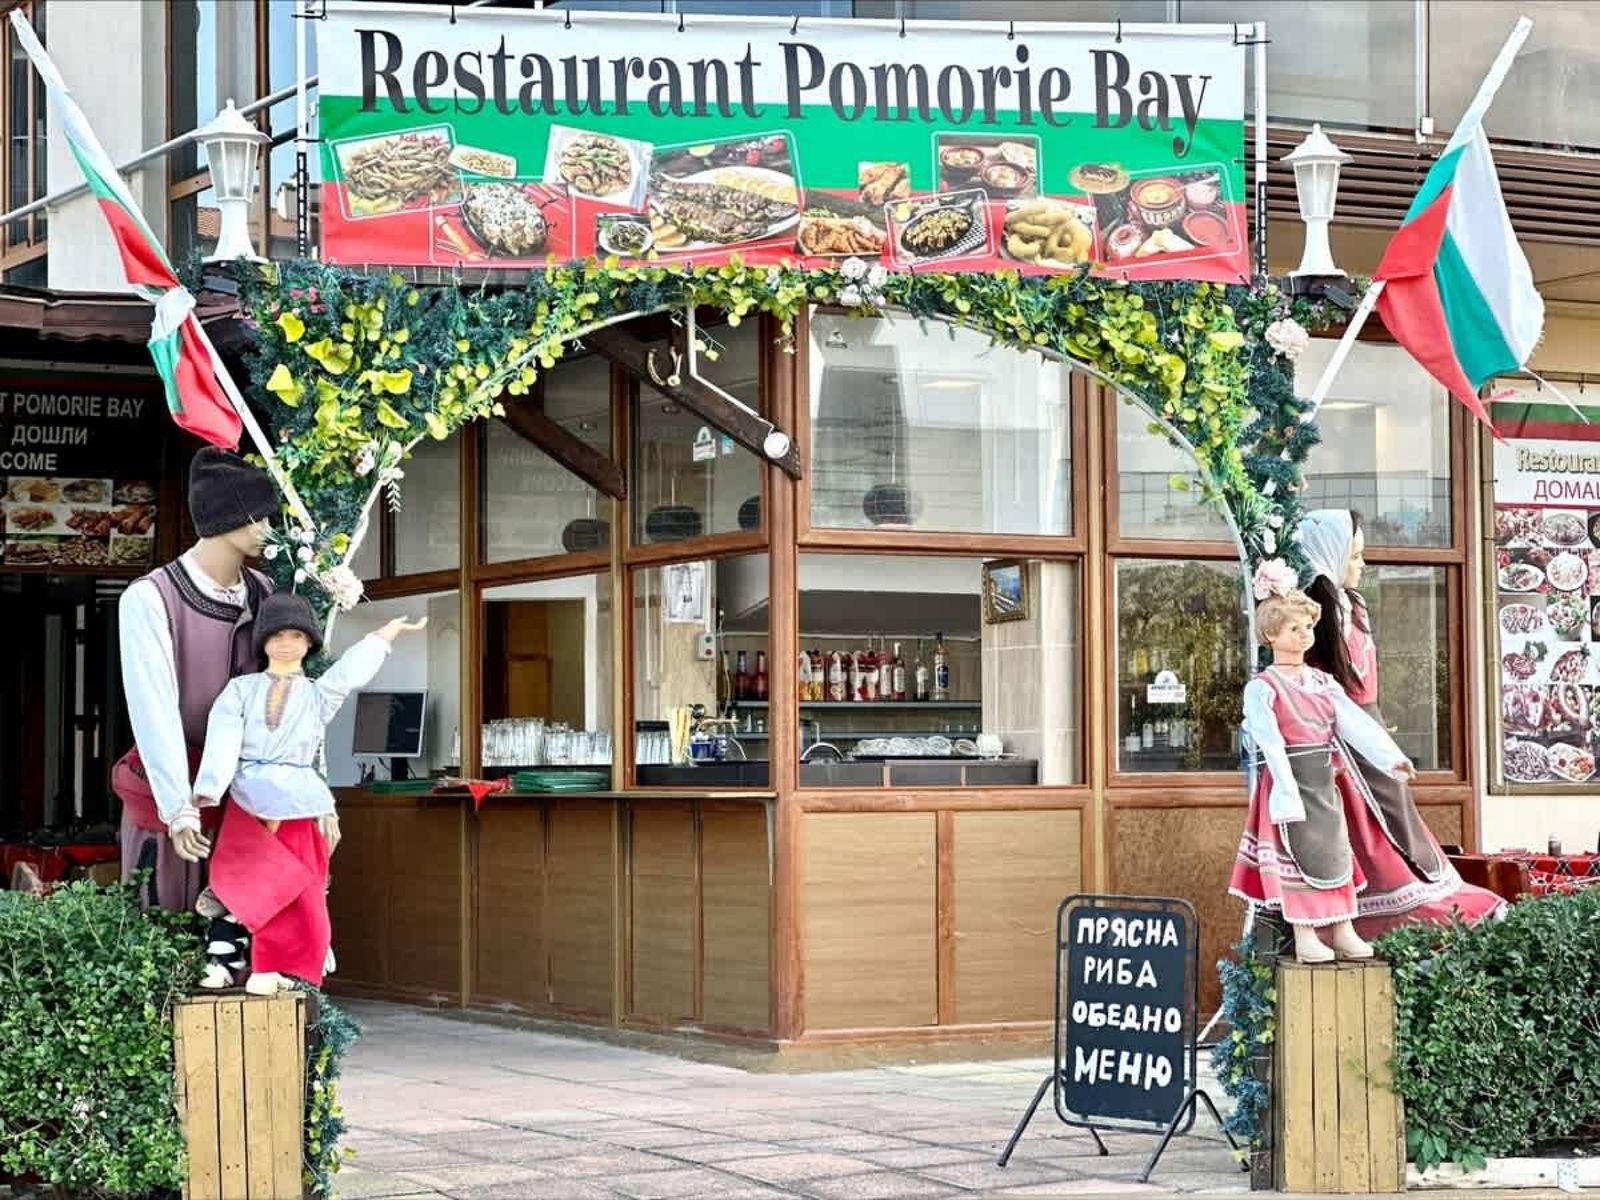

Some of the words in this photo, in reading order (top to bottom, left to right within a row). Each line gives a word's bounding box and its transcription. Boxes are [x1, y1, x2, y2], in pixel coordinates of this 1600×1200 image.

[353, 28, 767, 118] Restaurant
[778, 42, 1073, 126] Pomorie
[1088, 48, 1213, 158] Bay
[13, 393, 102, 417] POMORIE
[107, 397, 145, 418] BAY
[11, 424, 88, 446] ДОШЛИ
[0, 451, 58, 471] COME
[1516, 447, 1600, 474] Restoura
[1534, 479, 1600, 501] ДОМА
[1076, 916, 1179, 948] ПРЯСНА
[1083, 955, 1158, 989] РИБА
[1071, 1000, 1182, 1034] ОБЕДНО
[1073, 1045, 1173, 1091] МЕНЮ
